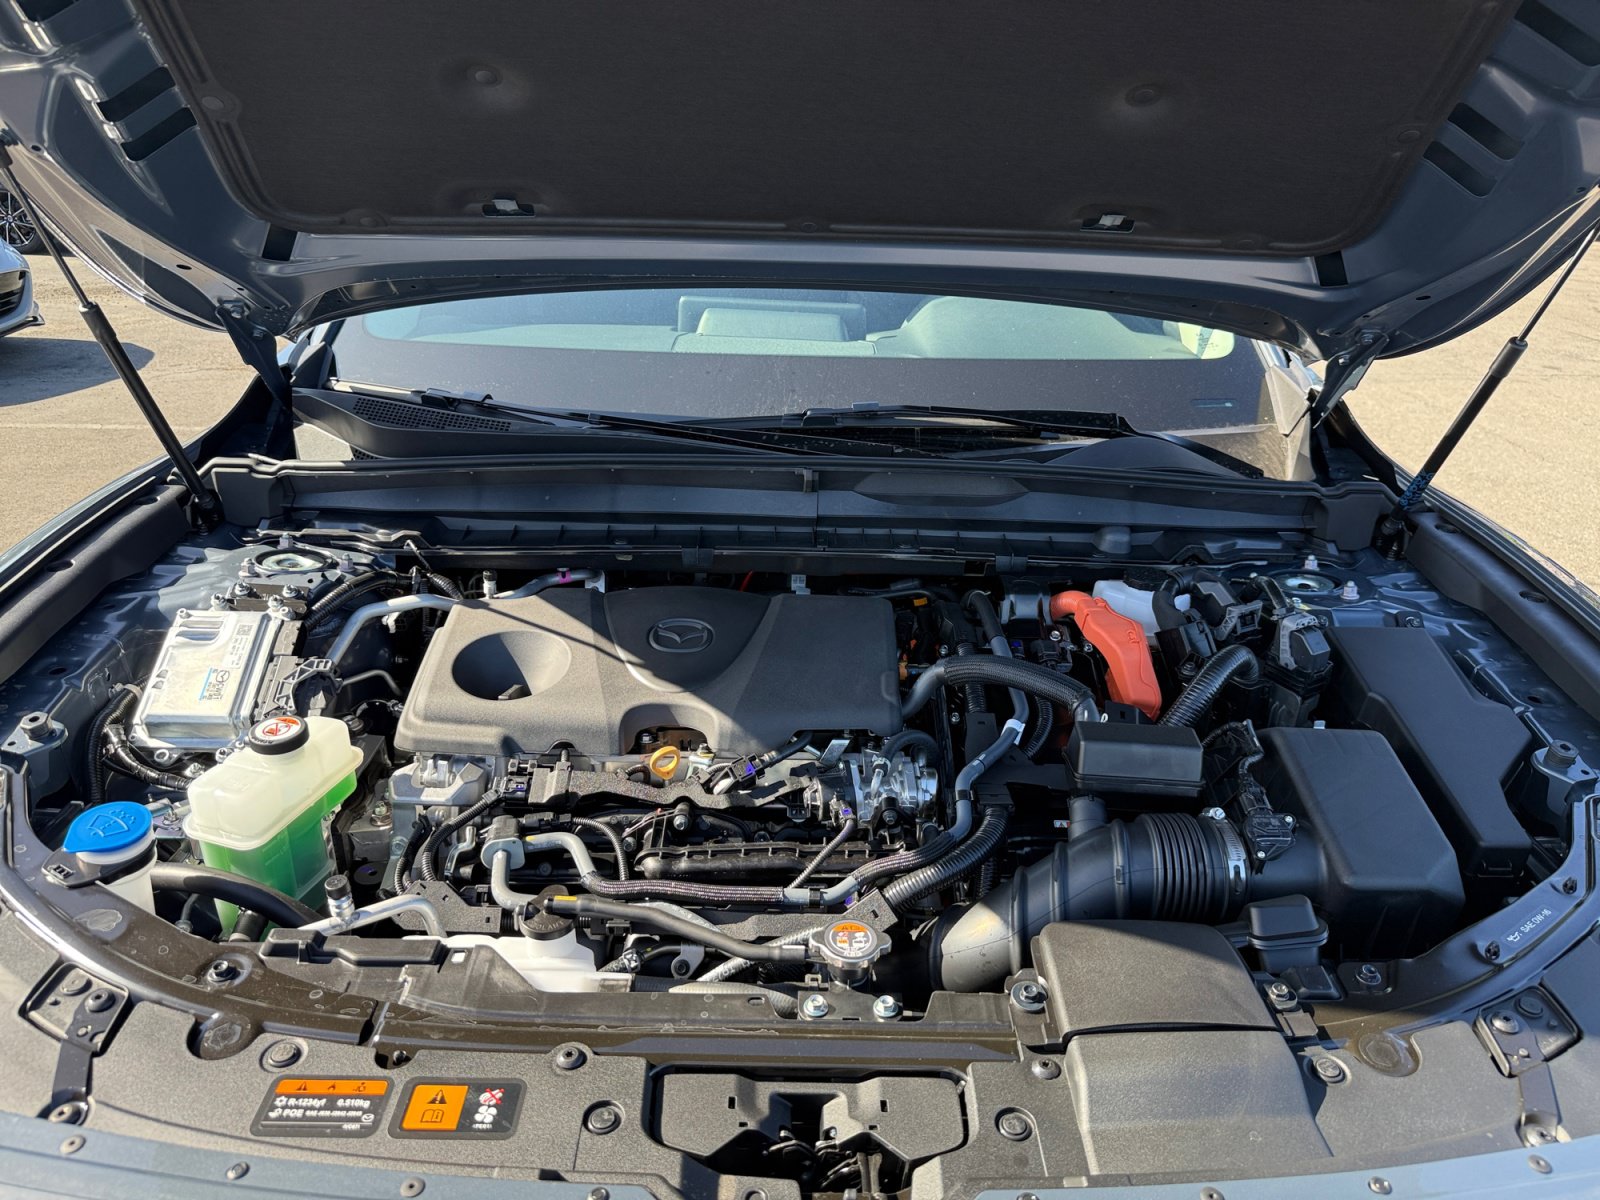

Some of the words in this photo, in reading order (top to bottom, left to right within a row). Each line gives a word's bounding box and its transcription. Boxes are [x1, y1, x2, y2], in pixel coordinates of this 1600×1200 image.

[1520, 921, 1536, 932] SAE
[1531, 909, 1552, 924] 0W-16
[287, 1097, 327, 1109] R-1234yf
[282, 1109, 305, 1118] POE
